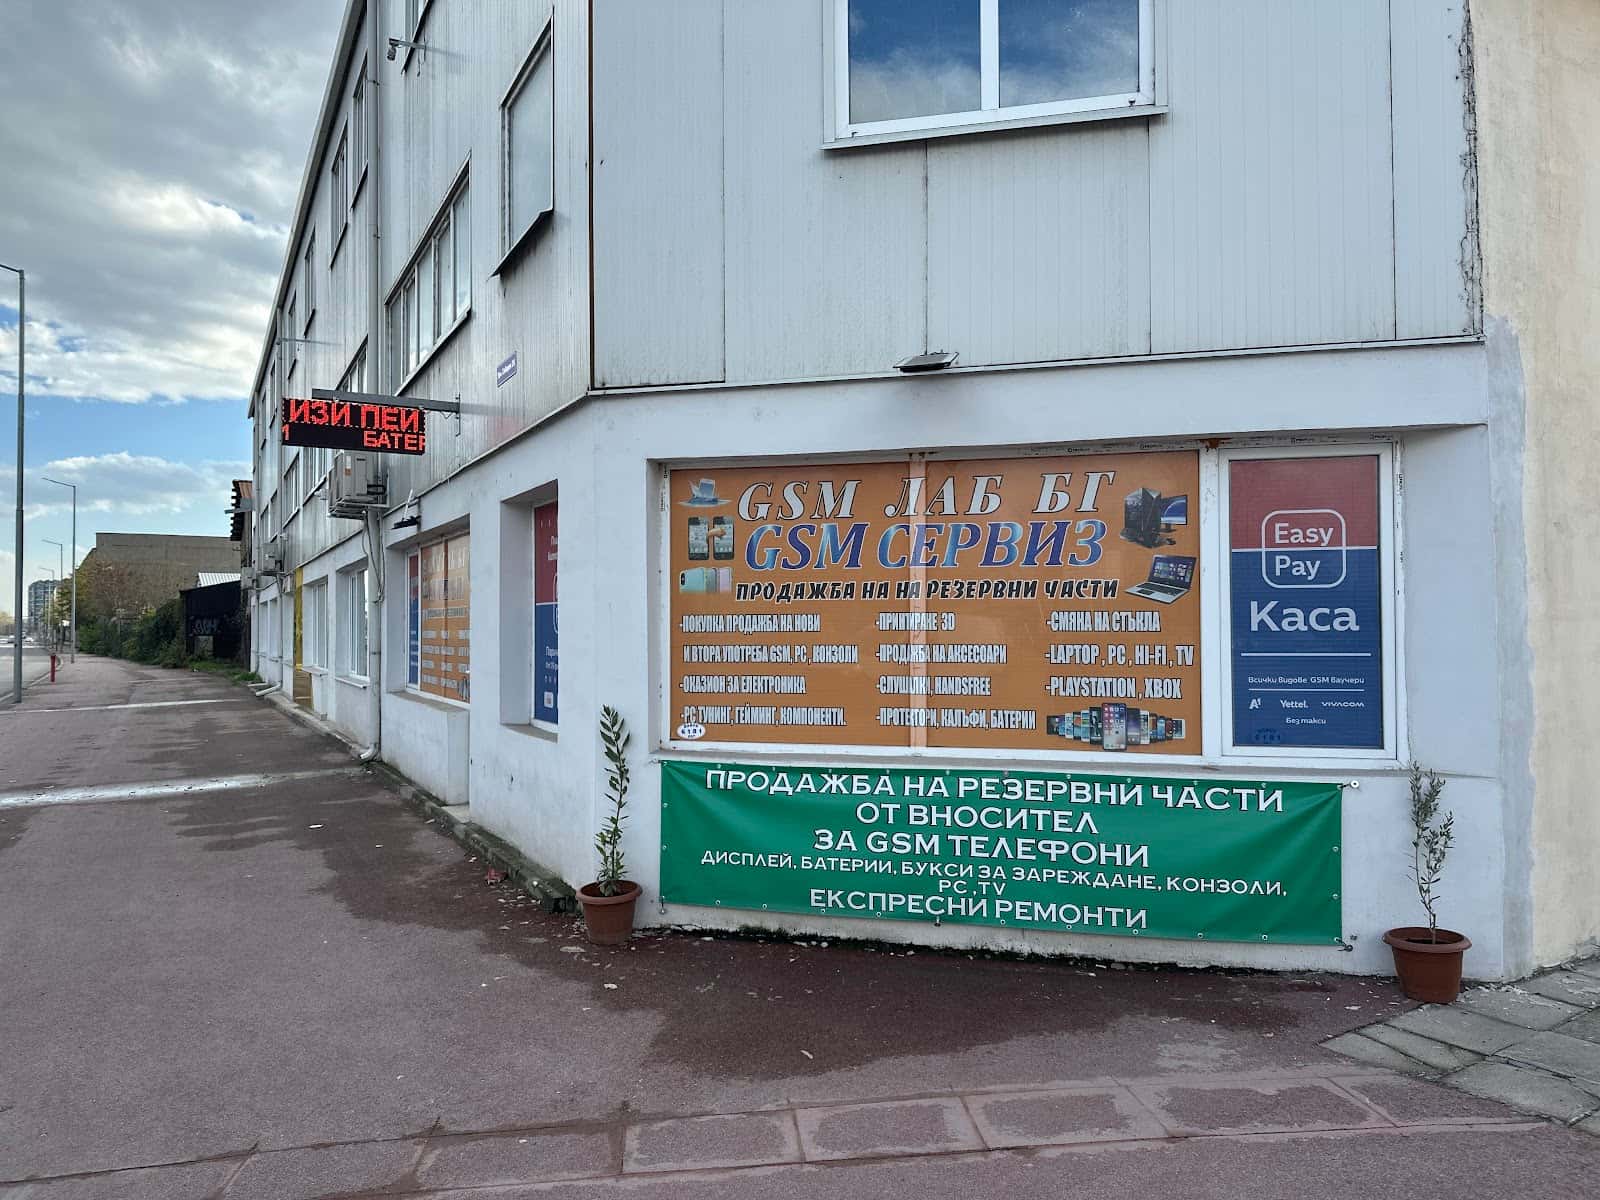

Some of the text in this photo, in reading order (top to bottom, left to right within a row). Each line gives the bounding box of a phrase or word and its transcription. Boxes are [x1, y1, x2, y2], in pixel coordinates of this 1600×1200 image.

[290, 399, 350, 426] ИЗИ
[737, 470, 1117, 521] GSM ЛАБ БГ
[745, 518, 1108, 570] GSM СЕРВИЗ
[1273, 521, 1334, 546] Easy
[1274, 555, 1320, 580] Pay
[735, 577, 1119, 603] ПРОДАЖБА НА НА РЕЗЕРВНИ ЧАСТИ
[726, 614, 779, 635] ПРОДАЖБА
[780, 614, 794, 632] НА
[794, 614, 821, 632] НОВИ
[941, 612, 956, 631] 3D
[1094, 611, 1110, 631] НА
[1111, 611, 1161, 632] СТЪКЛА
[1250, 600, 1360, 632] Каса
[683, 645, 690, 662] И
[691, 645, 723, 663] ВТОРА
[722, 645, 768, 663] УПОТРЕБА
[812, 645, 859, 663] КОНЗОЛИ
[932, 644, 948, 663] НА
[947, 644, 1008, 664] АКСЕСОАРИ
[1175, 645, 1194, 666] TV
[727, 676, 741, 693] ЗА
[741, 676, 807, 694] ЕЛЕКТРОНИКА
[934, 676, 991, 696] HANDSFREE
[1144, 677, 1182, 699] XBOX
[1310, 676, 1329, 684] GSM
[990, 710, 1036, 729] БАТЕРИИ
[705, 769, 1285, 812] ПРОДАЖБА НА РЕЗЕРВНИ ЧАСТИ
[856, 802, 1100, 834] ОТ ВНОСИТЕЛ
[813, 829, 1150, 868] ЗА GSM ТЕЛЕФОНИ
[701, 849, 797, 869] ДИСПЛЕЙ,
[801, 856, 898, 876] БАТЕРИИ,
[901, 861, 974, 878] БУКСИ
[978, 865, 1007, 880] ЗА
[1012, 867, 1162, 892] ЗАРЕЖДАНЕ,
[810, 888, 1148, 930] ЕКСПРЕСНИ РЕМОНТИ
